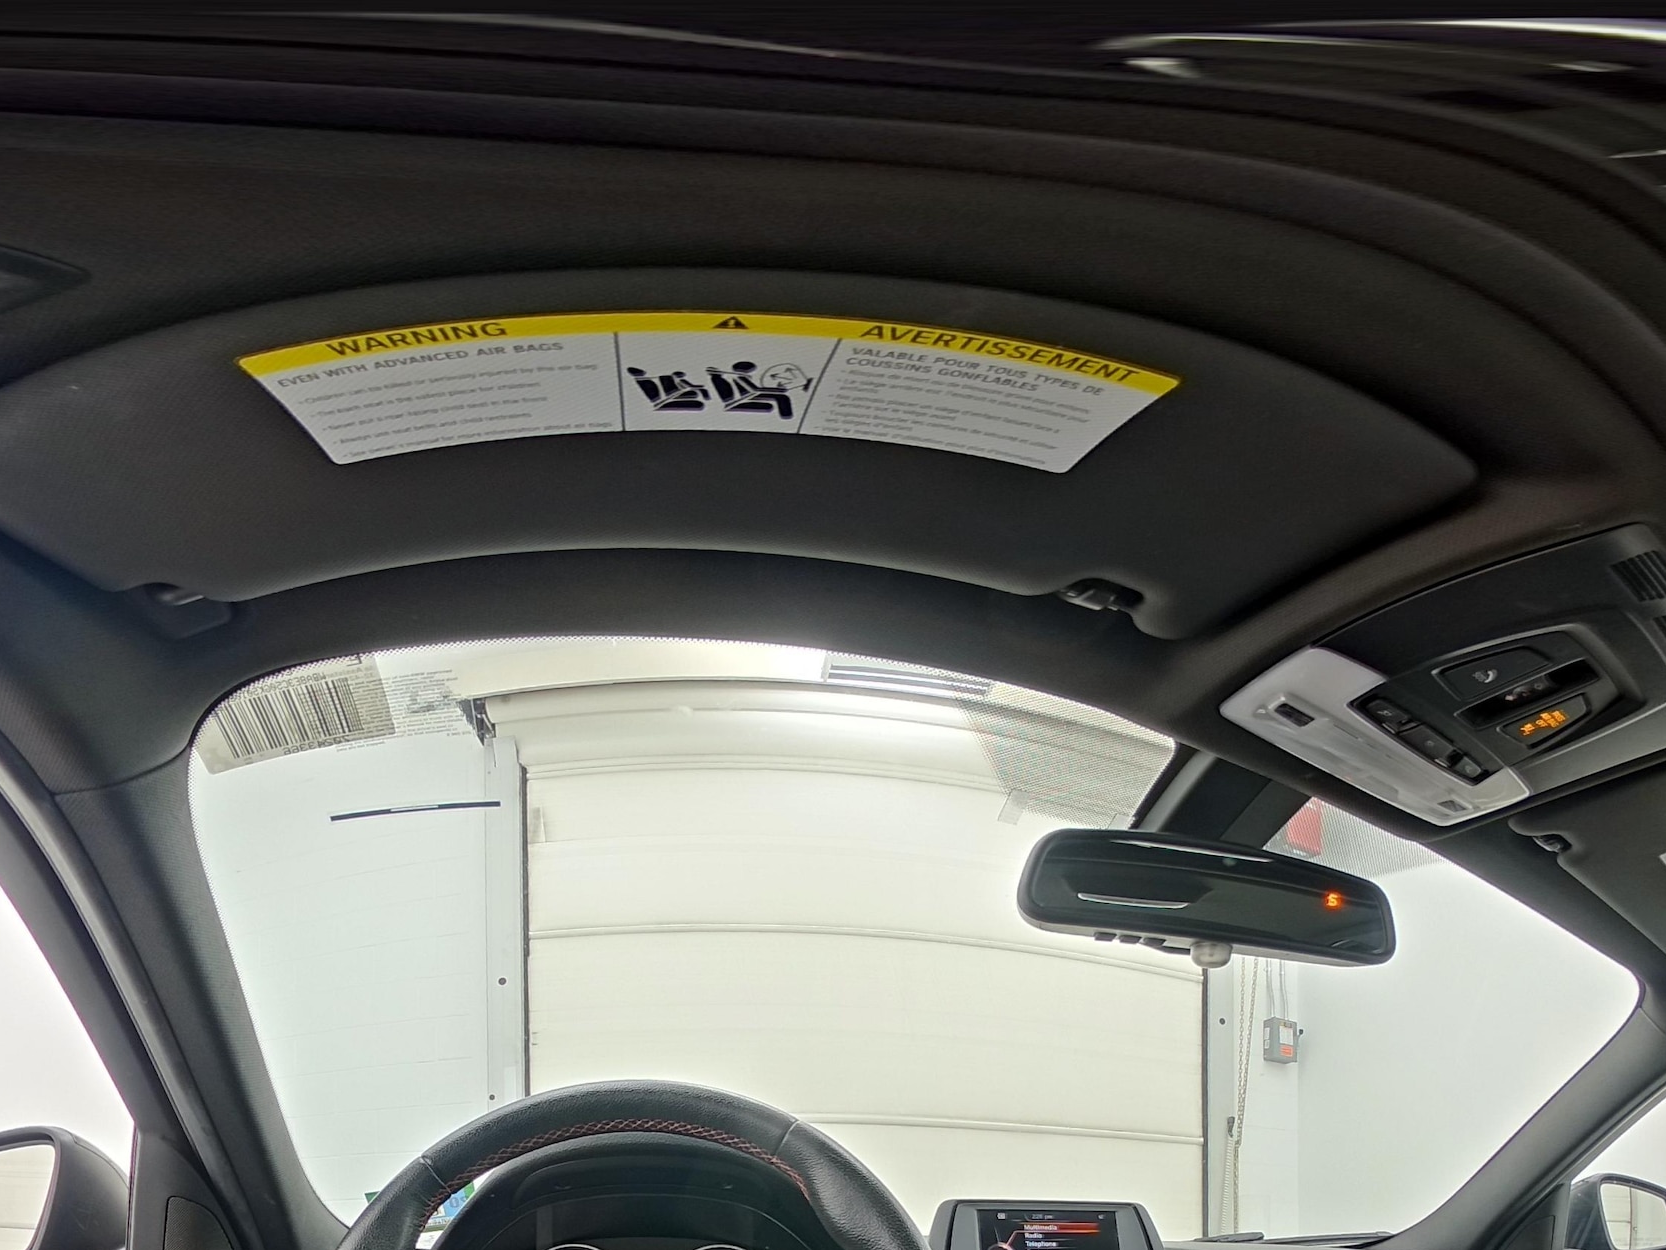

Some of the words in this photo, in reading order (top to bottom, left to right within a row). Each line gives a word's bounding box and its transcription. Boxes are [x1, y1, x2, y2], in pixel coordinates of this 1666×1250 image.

[326, 322, 507, 356] WARNING
[860, 325, 1140, 382] AVERTISSEMENT
[277, 372, 320, 388] EVEN
[323, 364, 368, 378] WITH
[374, 350, 469, 370] ADVANCED
[476, 346, 506, 357] AIR
[513, 342, 564, 354] BAGS
[846, 356, 933, 374] COUSSINS
[937, 367, 1039, 392] GONFLABLES
[852, 346, 930, 363] VALABLE
[932, 356, 981, 371] POUR
[986, 364, 1028, 379] TOUS
[1034, 373, 1081, 390] TYPES
[1082, 385, 1105, 396] DE
[1025, 1241, 1057, 1249] Telephone
